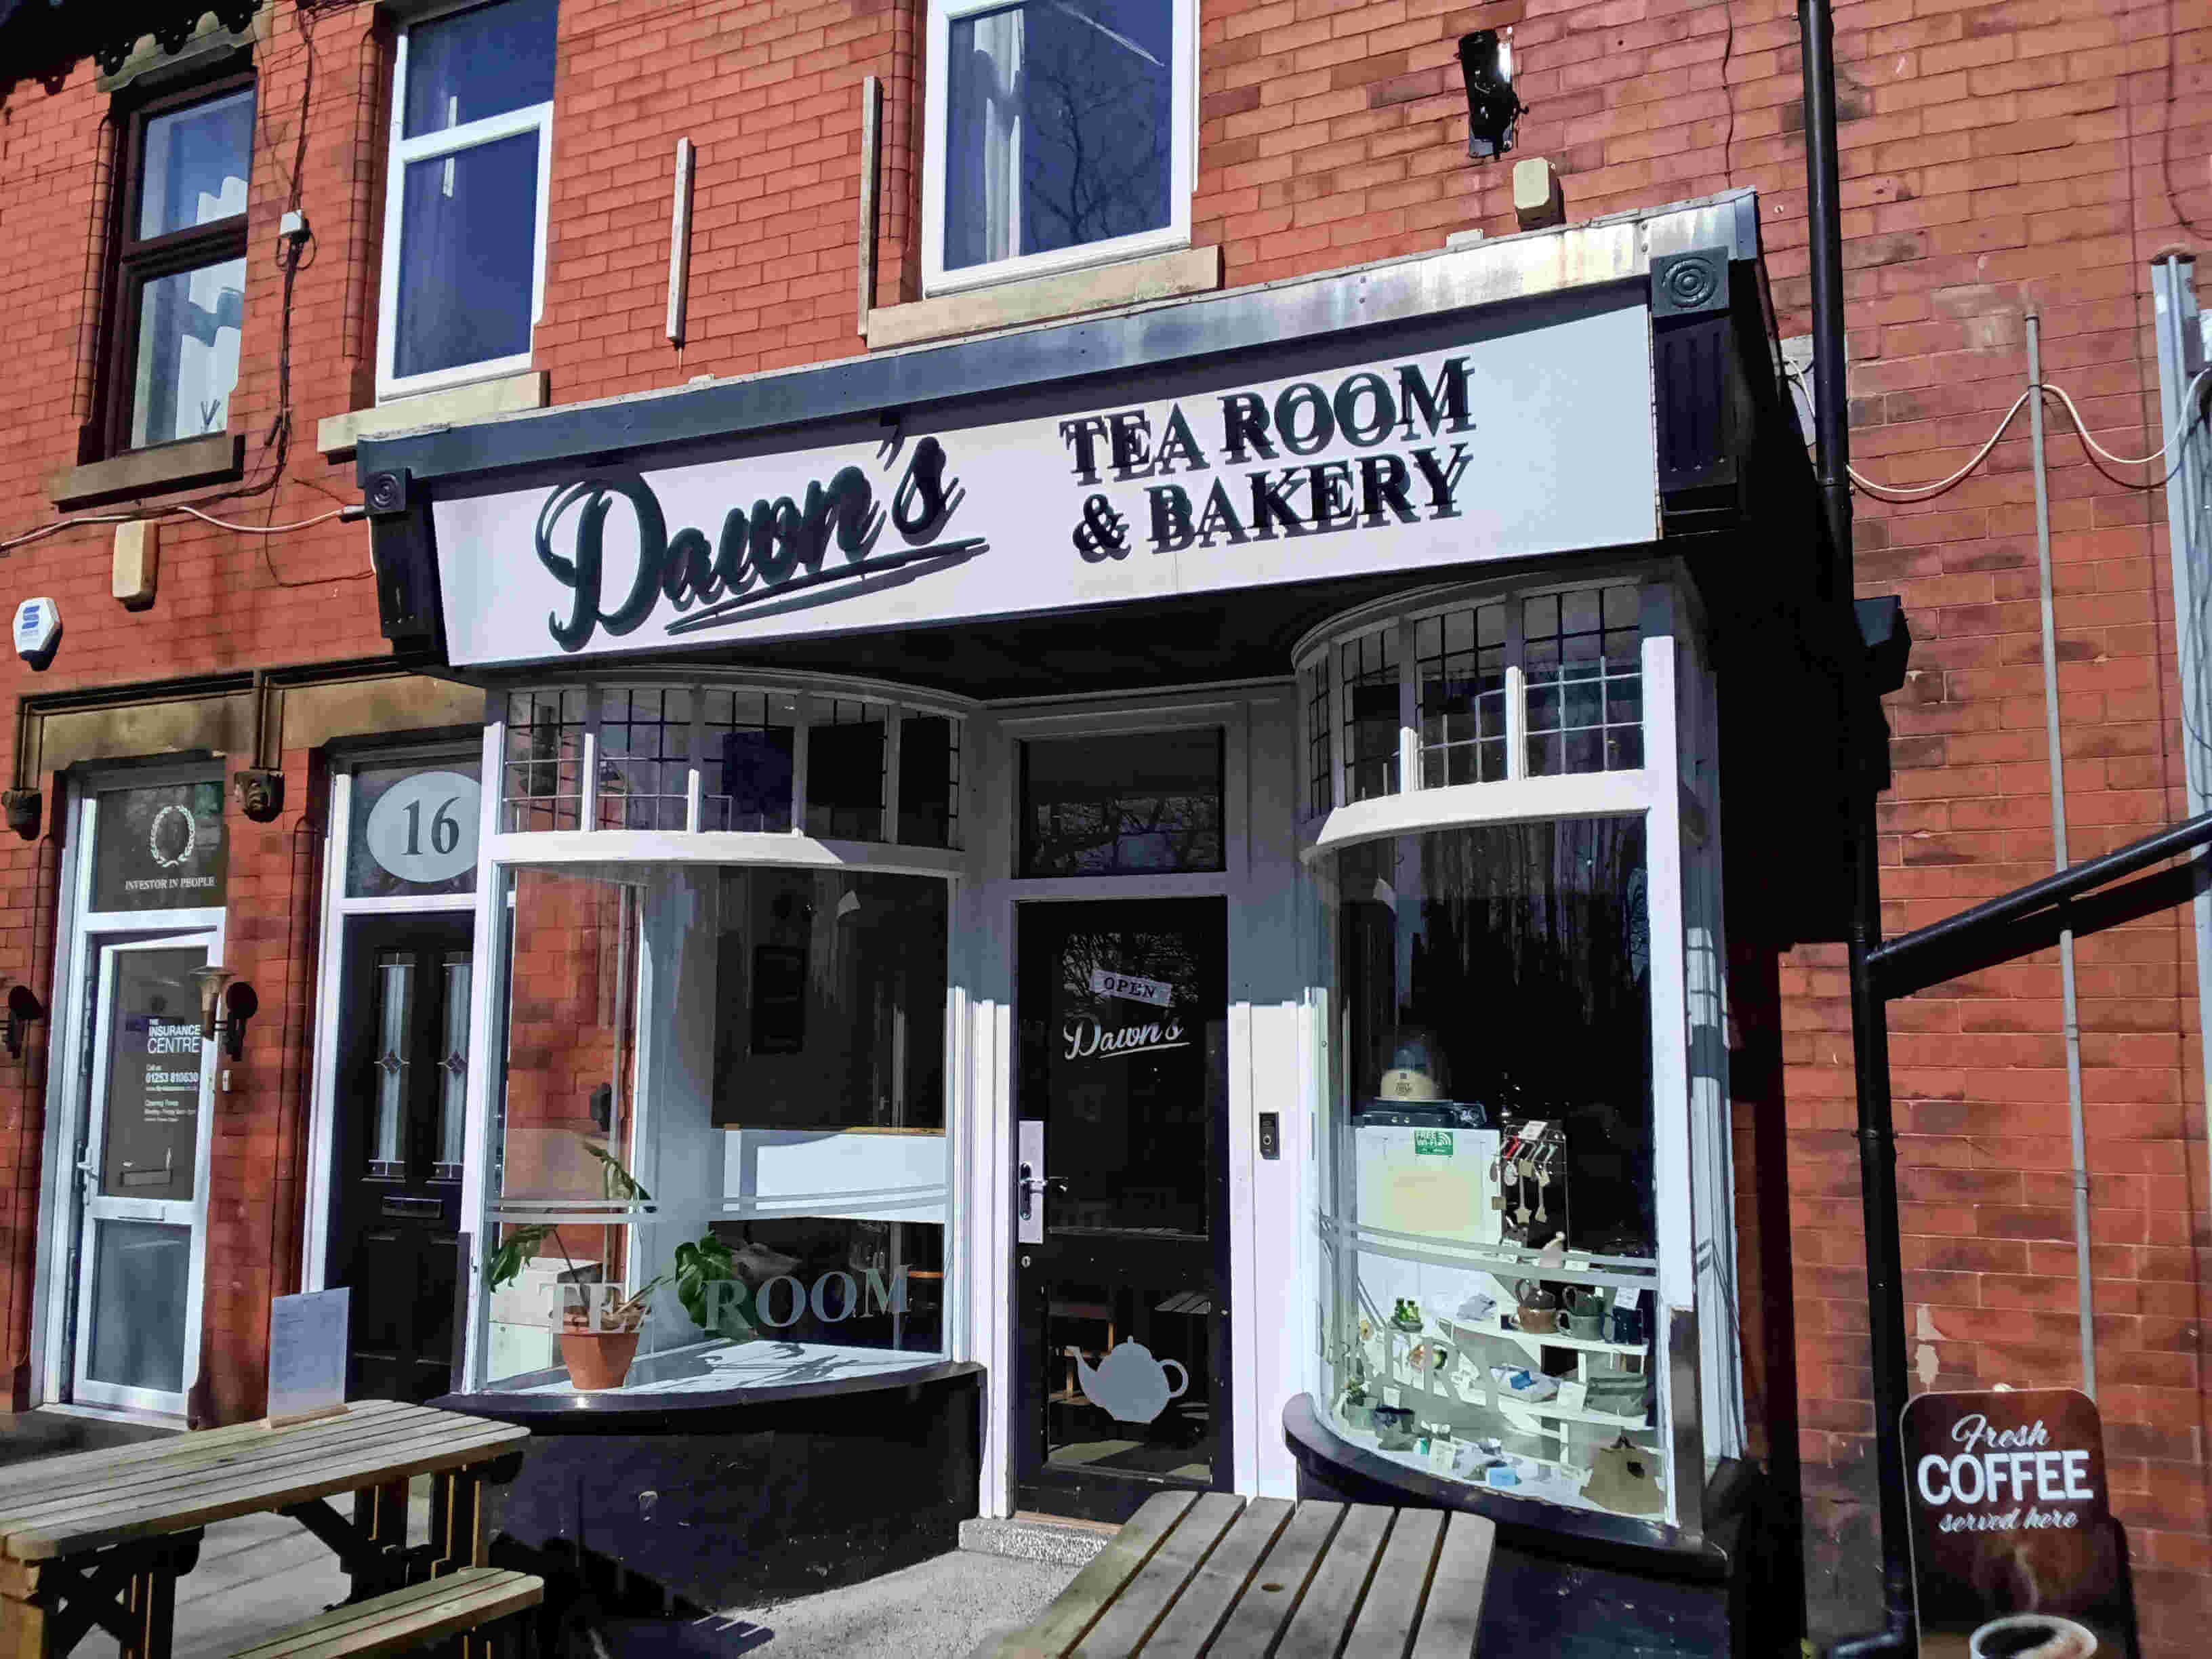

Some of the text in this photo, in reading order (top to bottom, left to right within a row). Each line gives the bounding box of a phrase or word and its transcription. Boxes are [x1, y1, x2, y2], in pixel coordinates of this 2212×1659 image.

[1059, 355, 1477, 487] TEA ROOM
[1072, 442, 1474, 563] & BAKERY
[535, 422, 966, 653] Dawn's
[401, 796, 461, 856] 16
[125, 876, 215, 890] INVESTOR IN PEOPLE
[1103, 977, 1156, 999] OPEN
[147, 1036, 201, 1054] CENTRE
[148, 1024, 201, 1037] INSURANCE
[1063, 1010, 1185, 1061] Dawn's
[703, 1263, 912, 1330] ROOM
[1951, 1414, 2050, 1454] Fresh
[1917, 1450, 2094, 1505] COFFEE
[1938, 1505, 2079, 1534] served here
